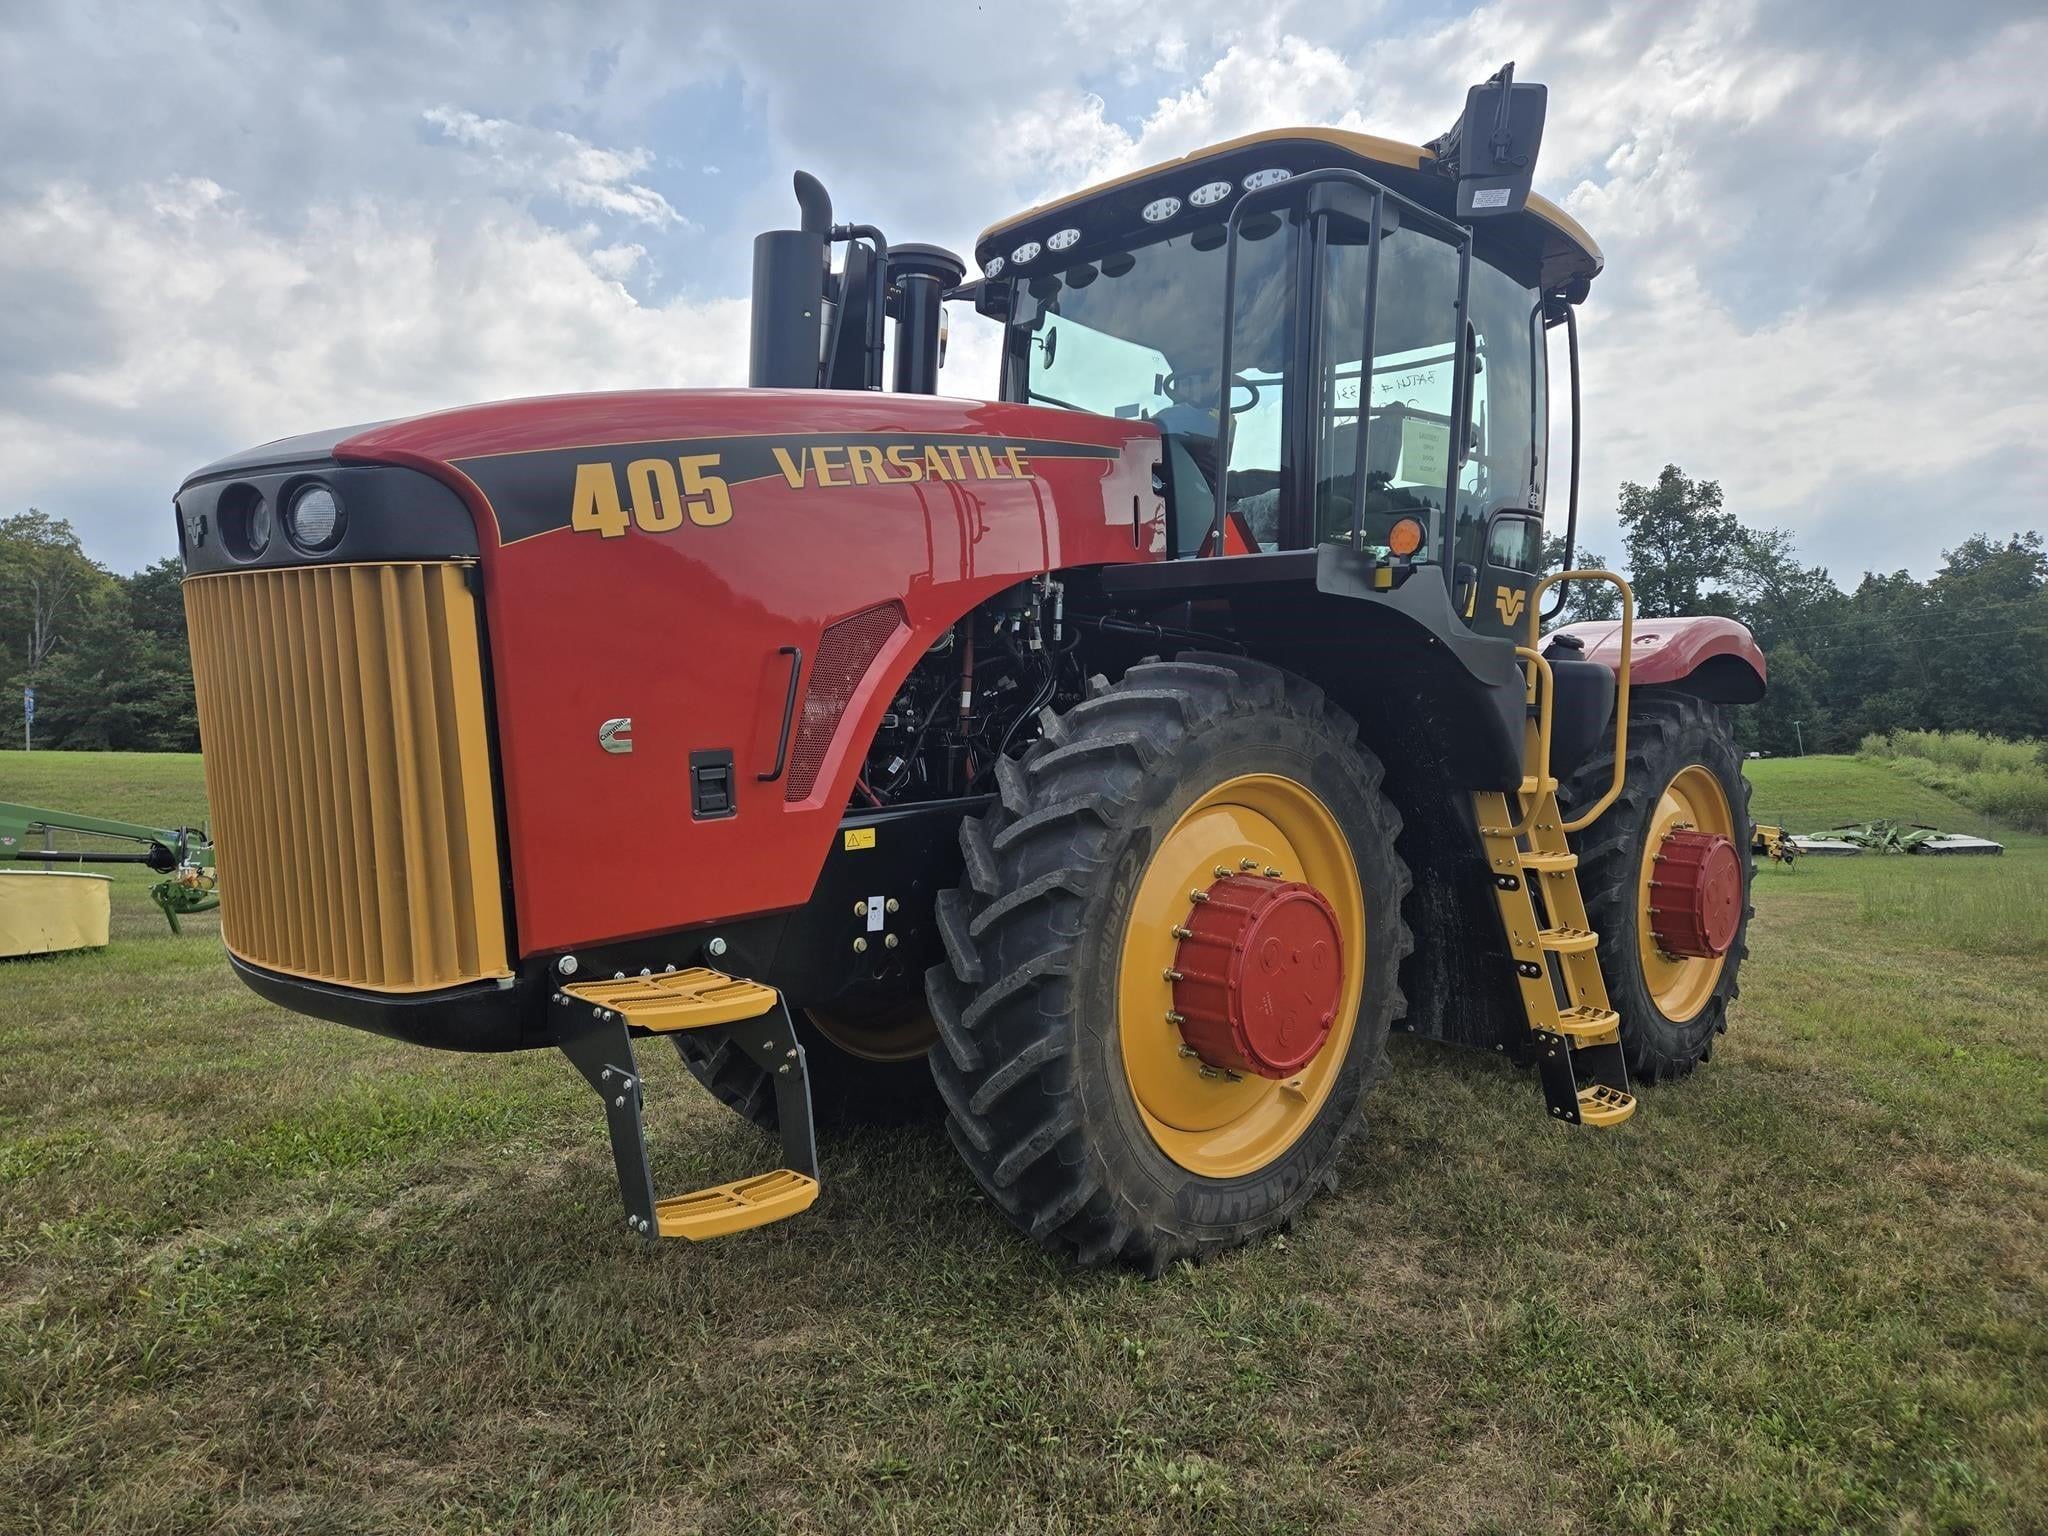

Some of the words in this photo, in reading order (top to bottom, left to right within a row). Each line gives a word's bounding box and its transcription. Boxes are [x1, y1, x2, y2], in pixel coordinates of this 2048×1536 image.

[572, 453, 733, 538] 405
[771, 445, 1036, 489] VERSATILE
[600, 719, 628, 741] Cummins
